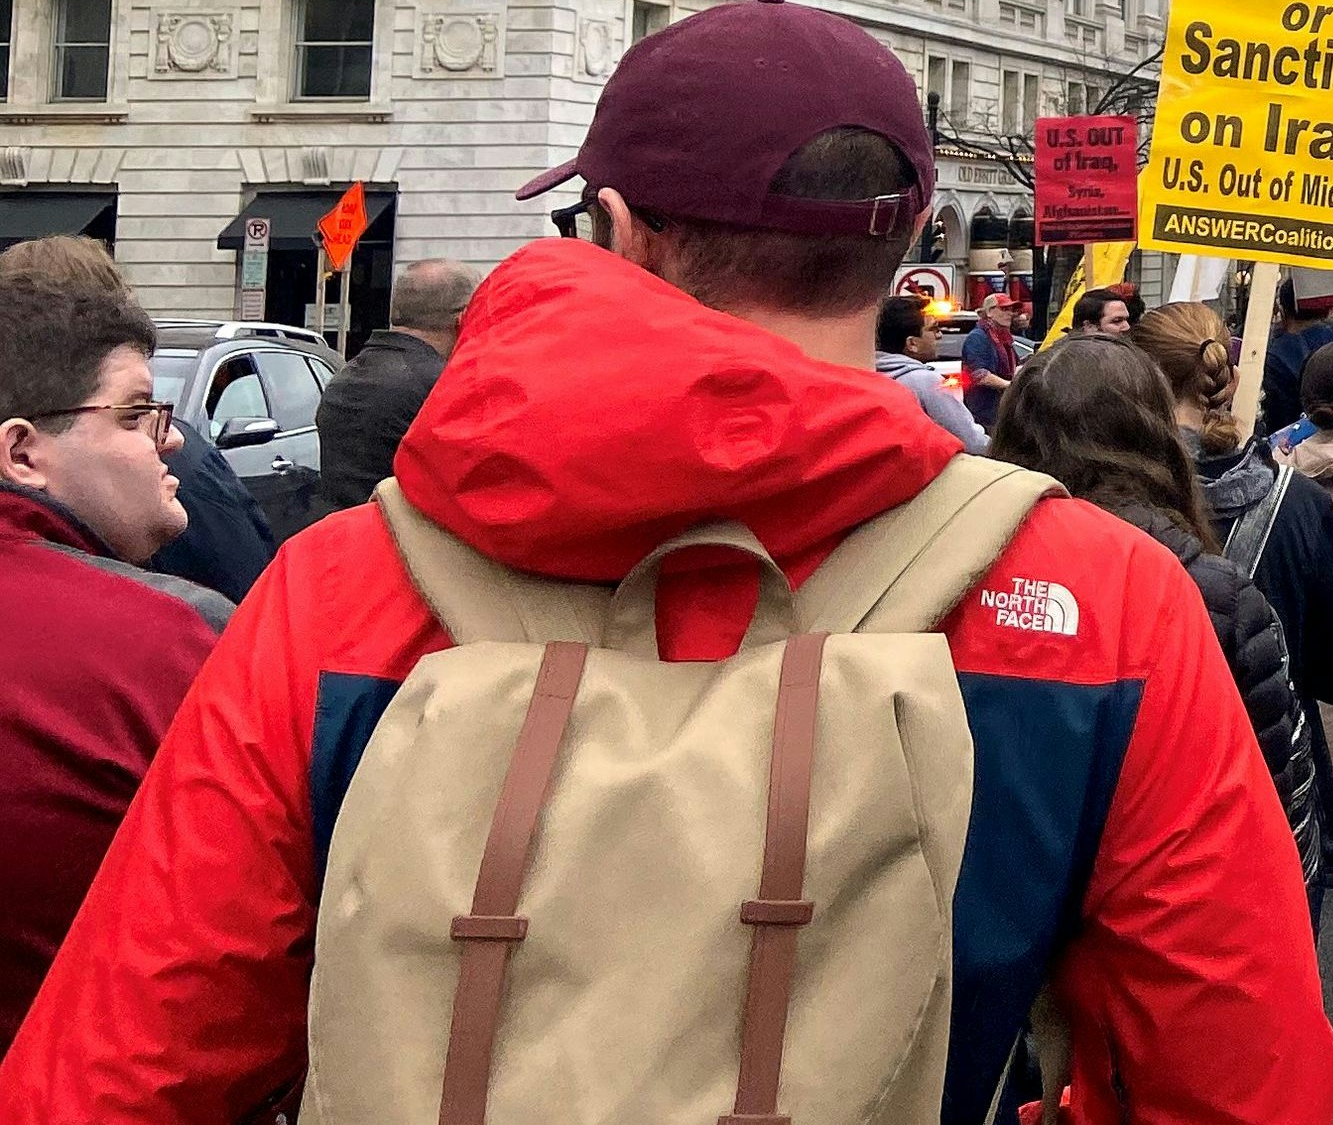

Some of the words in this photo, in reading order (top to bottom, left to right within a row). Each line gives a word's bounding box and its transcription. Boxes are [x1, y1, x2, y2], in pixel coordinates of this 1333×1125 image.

[1046, 128, 1083, 148] U.S.
[1087, 127, 1124, 147] OUT
[1180, 111, 1243, 148] on
[1054, 151, 1071, 171] of
[1162, 157, 1209, 193] U.S.
[1219, 163, 1262, 199] Out
[1269, 171, 1295, 202] of
[1012, 577, 1048, 597] THE
[981, 589, 1046, 614] NORTH
[996, 609, 1044, 631] FACE
